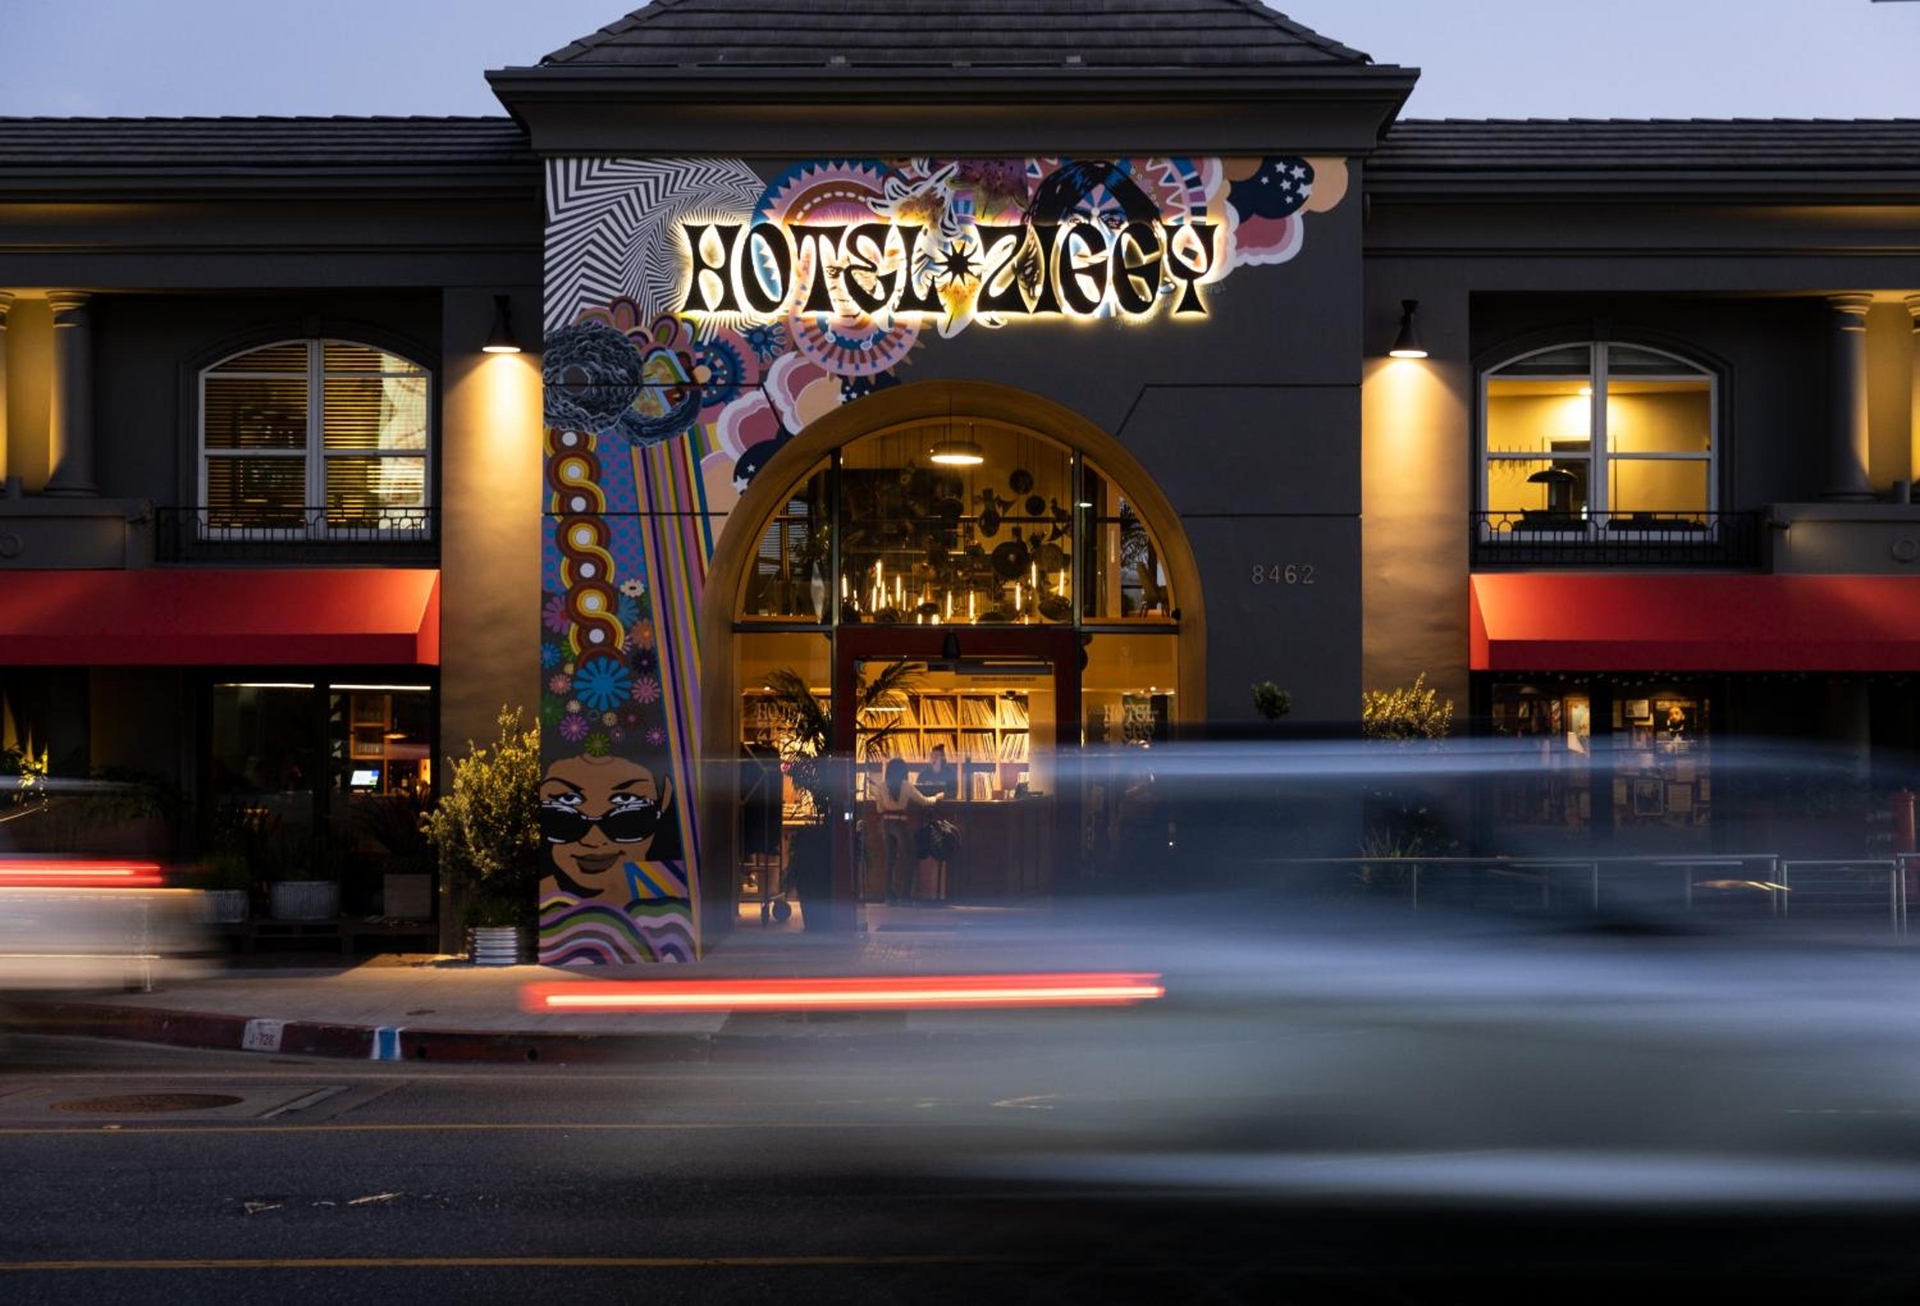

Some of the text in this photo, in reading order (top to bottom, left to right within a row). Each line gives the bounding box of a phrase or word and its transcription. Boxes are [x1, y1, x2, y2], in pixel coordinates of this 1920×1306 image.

[681, 222, 1219, 315] HOTEL ZIGGY
[1251, 565, 1314, 584] 8462
